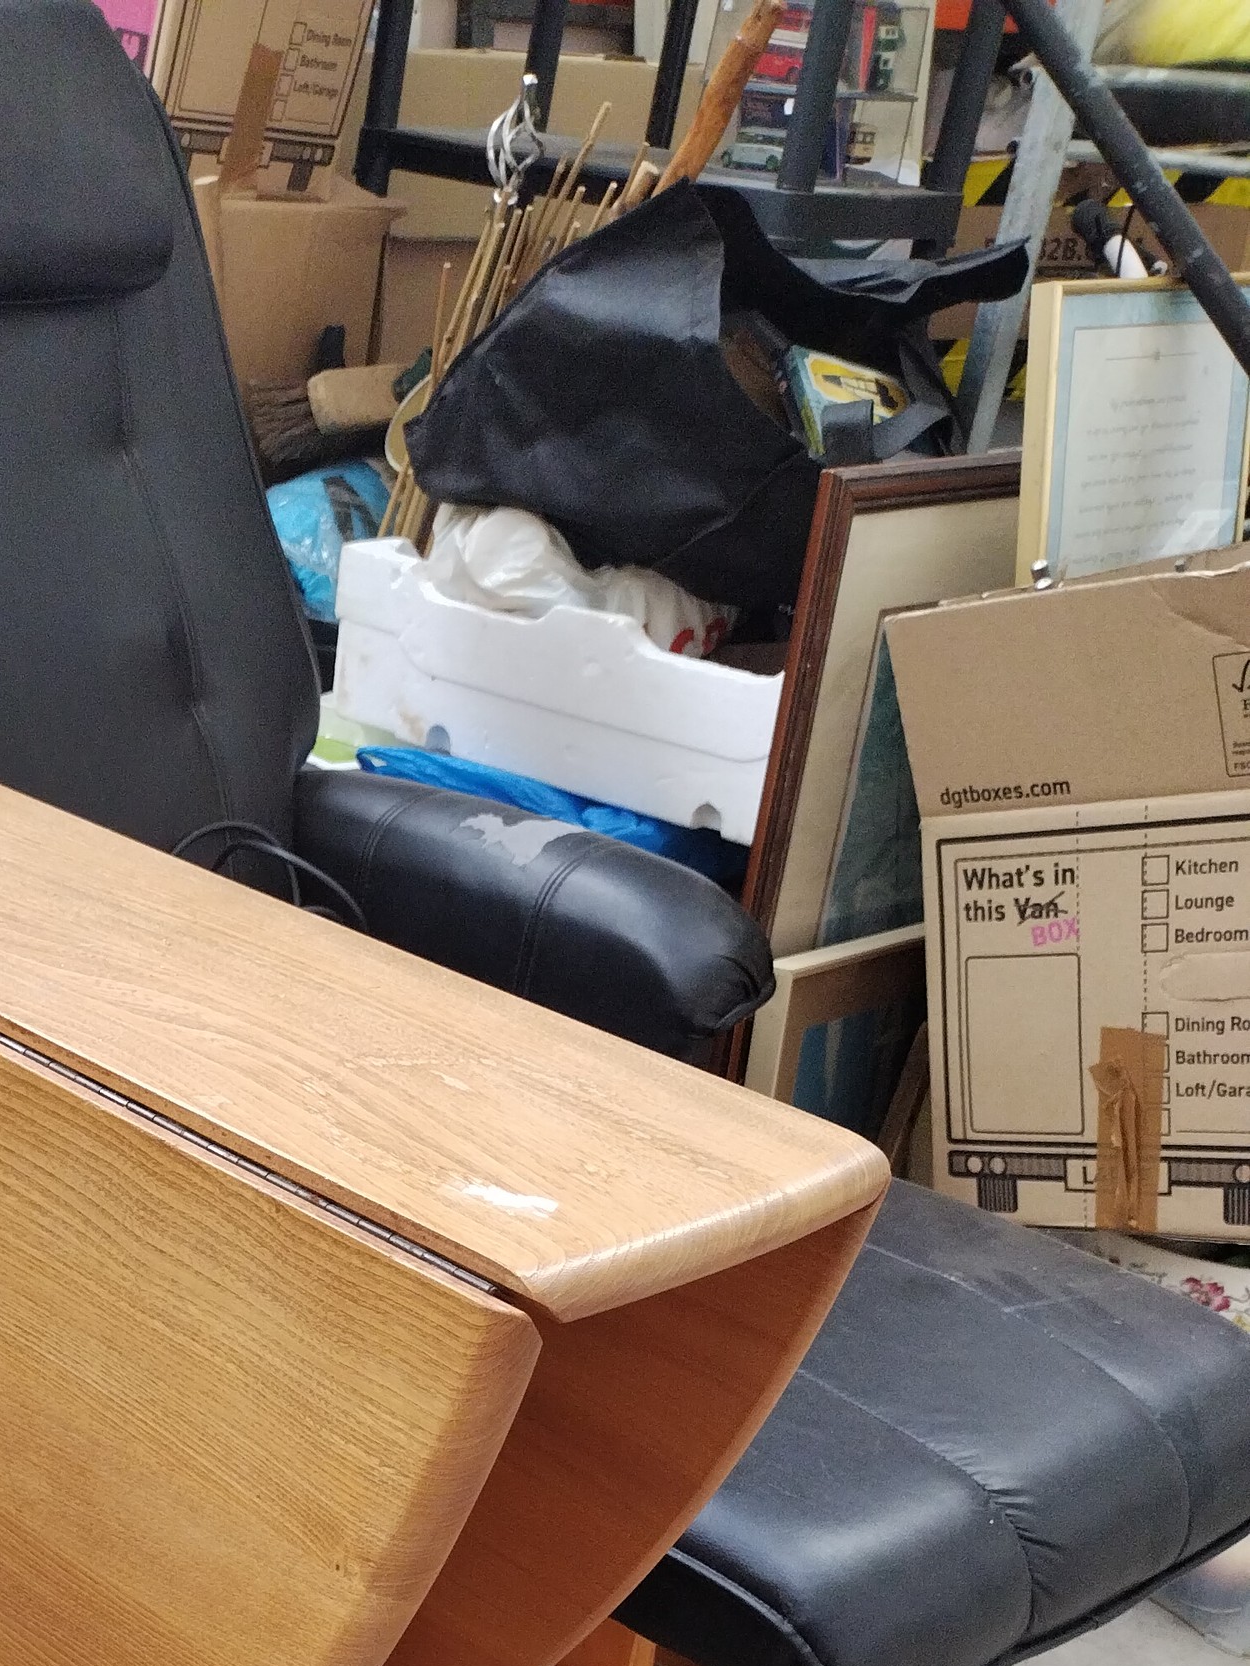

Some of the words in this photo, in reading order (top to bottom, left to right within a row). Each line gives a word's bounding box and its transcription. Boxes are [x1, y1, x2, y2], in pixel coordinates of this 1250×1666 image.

[940, 780, 1071, 808] dgtboxes.com
[963, 865, 1045, 891] What's
[1054, 862, 1075, 886] in
[1175, 859, 1239, 876] Kitchen
[963, 900, 1006, 922] this
[1175, 895, 1235, 912] Lounge
[1031, 916, 1079, 947] BOX
[1175, 928, 1249, 943] Bedroom
[1175, 1017, 1225, 1035] Dining
